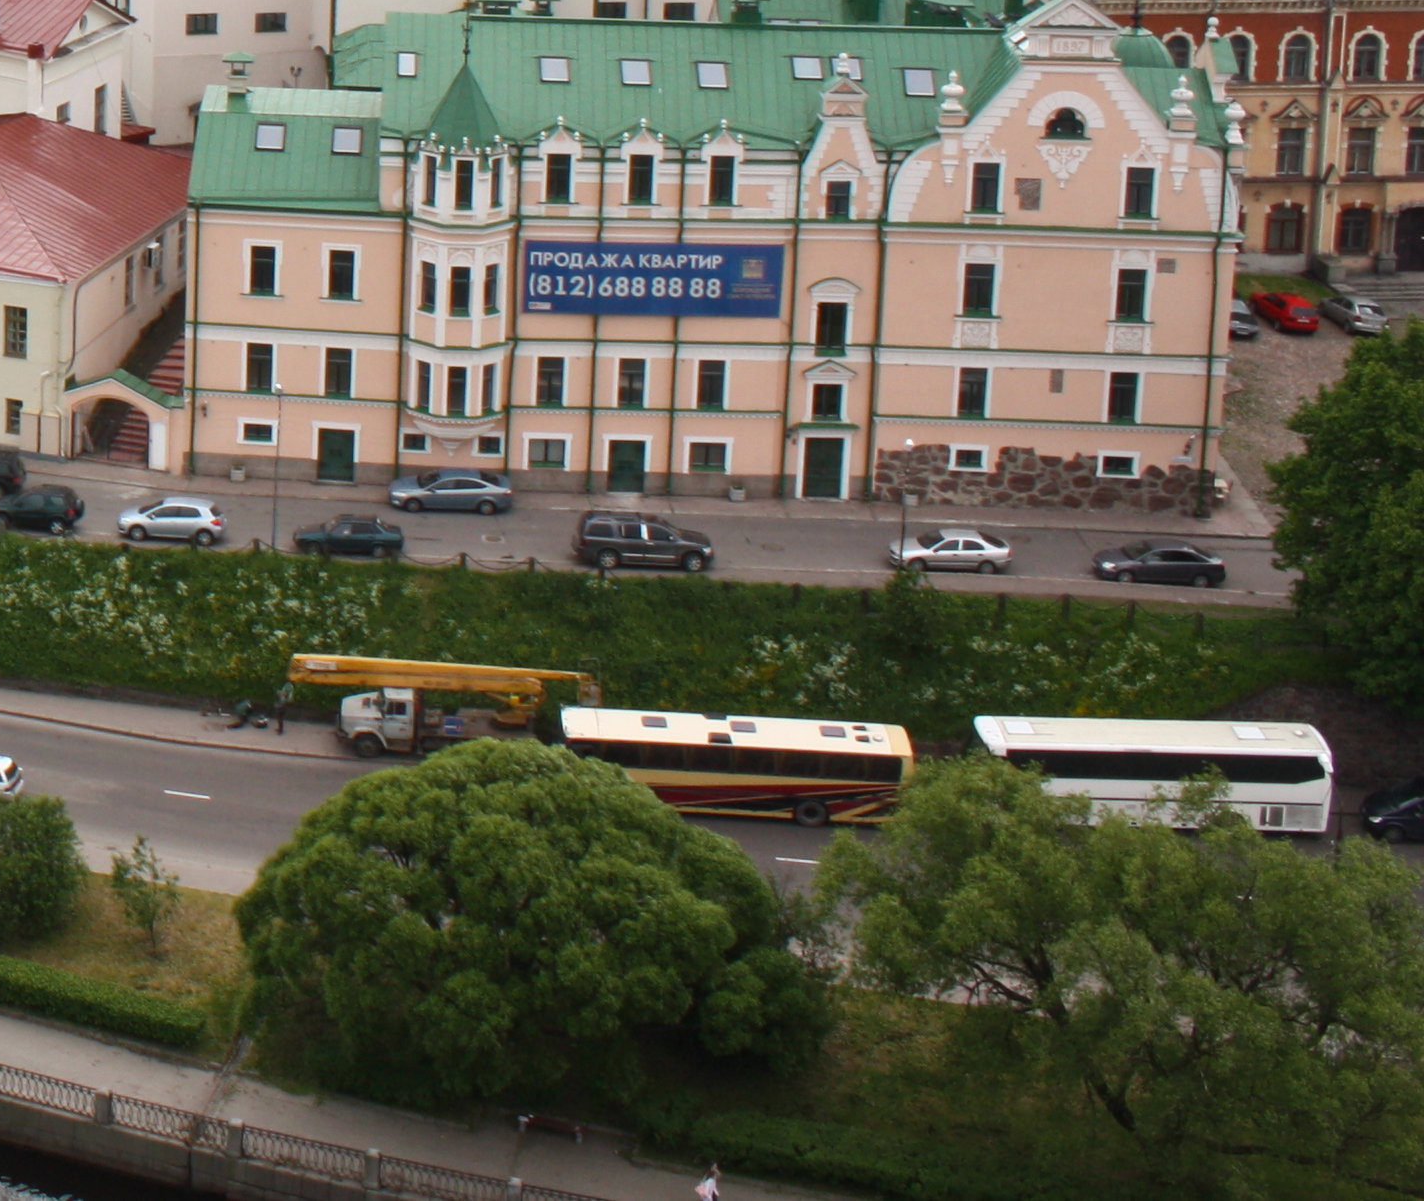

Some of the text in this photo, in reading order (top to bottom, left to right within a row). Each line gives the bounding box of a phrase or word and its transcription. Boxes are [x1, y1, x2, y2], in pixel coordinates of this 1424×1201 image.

[530, 251, 723, 269] ПРОДАЖА КВАРТИР
[651, 277, 683, 297] 88
[689, 278, 721, 298] 88
